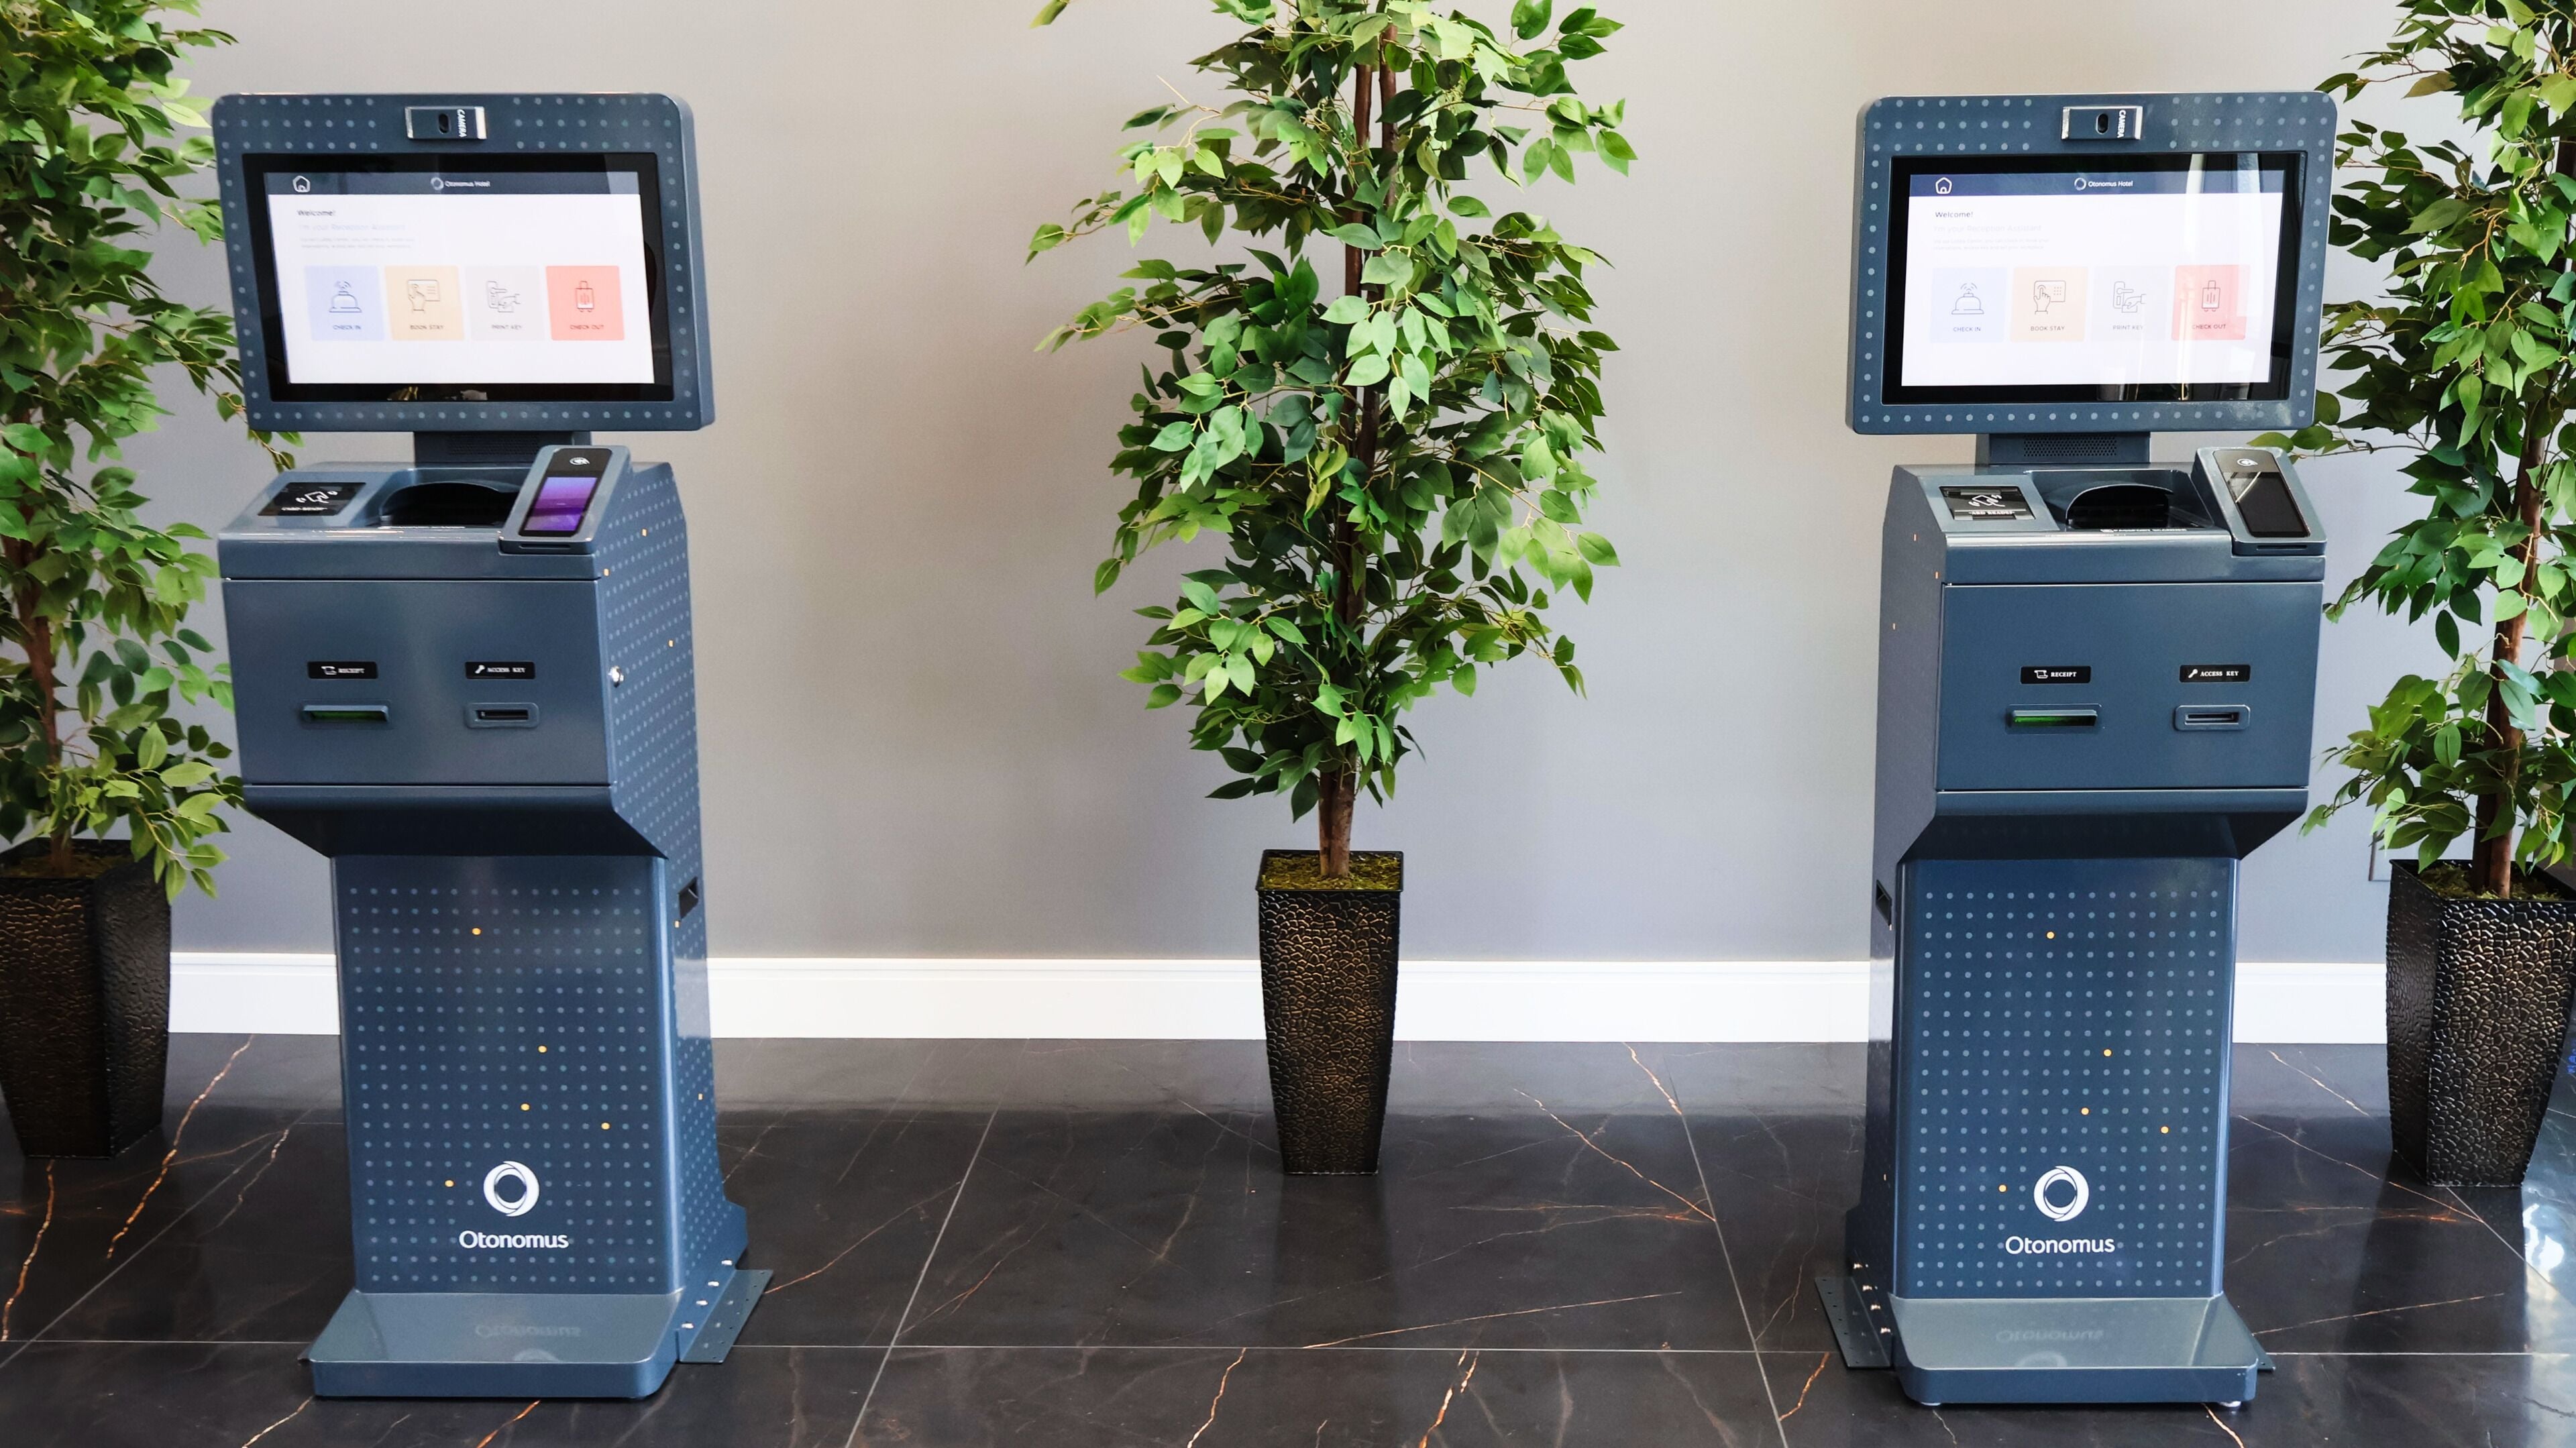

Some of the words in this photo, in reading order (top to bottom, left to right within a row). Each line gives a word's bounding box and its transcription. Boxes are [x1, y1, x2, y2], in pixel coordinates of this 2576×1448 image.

[457, 109, 468, 137] CAMERA
[2116, 109, 2127, 139] CAMERA
[459, 1230, 569, 1249] Otonomus
[2005, 1235, 2115, 1254] Otonomus
